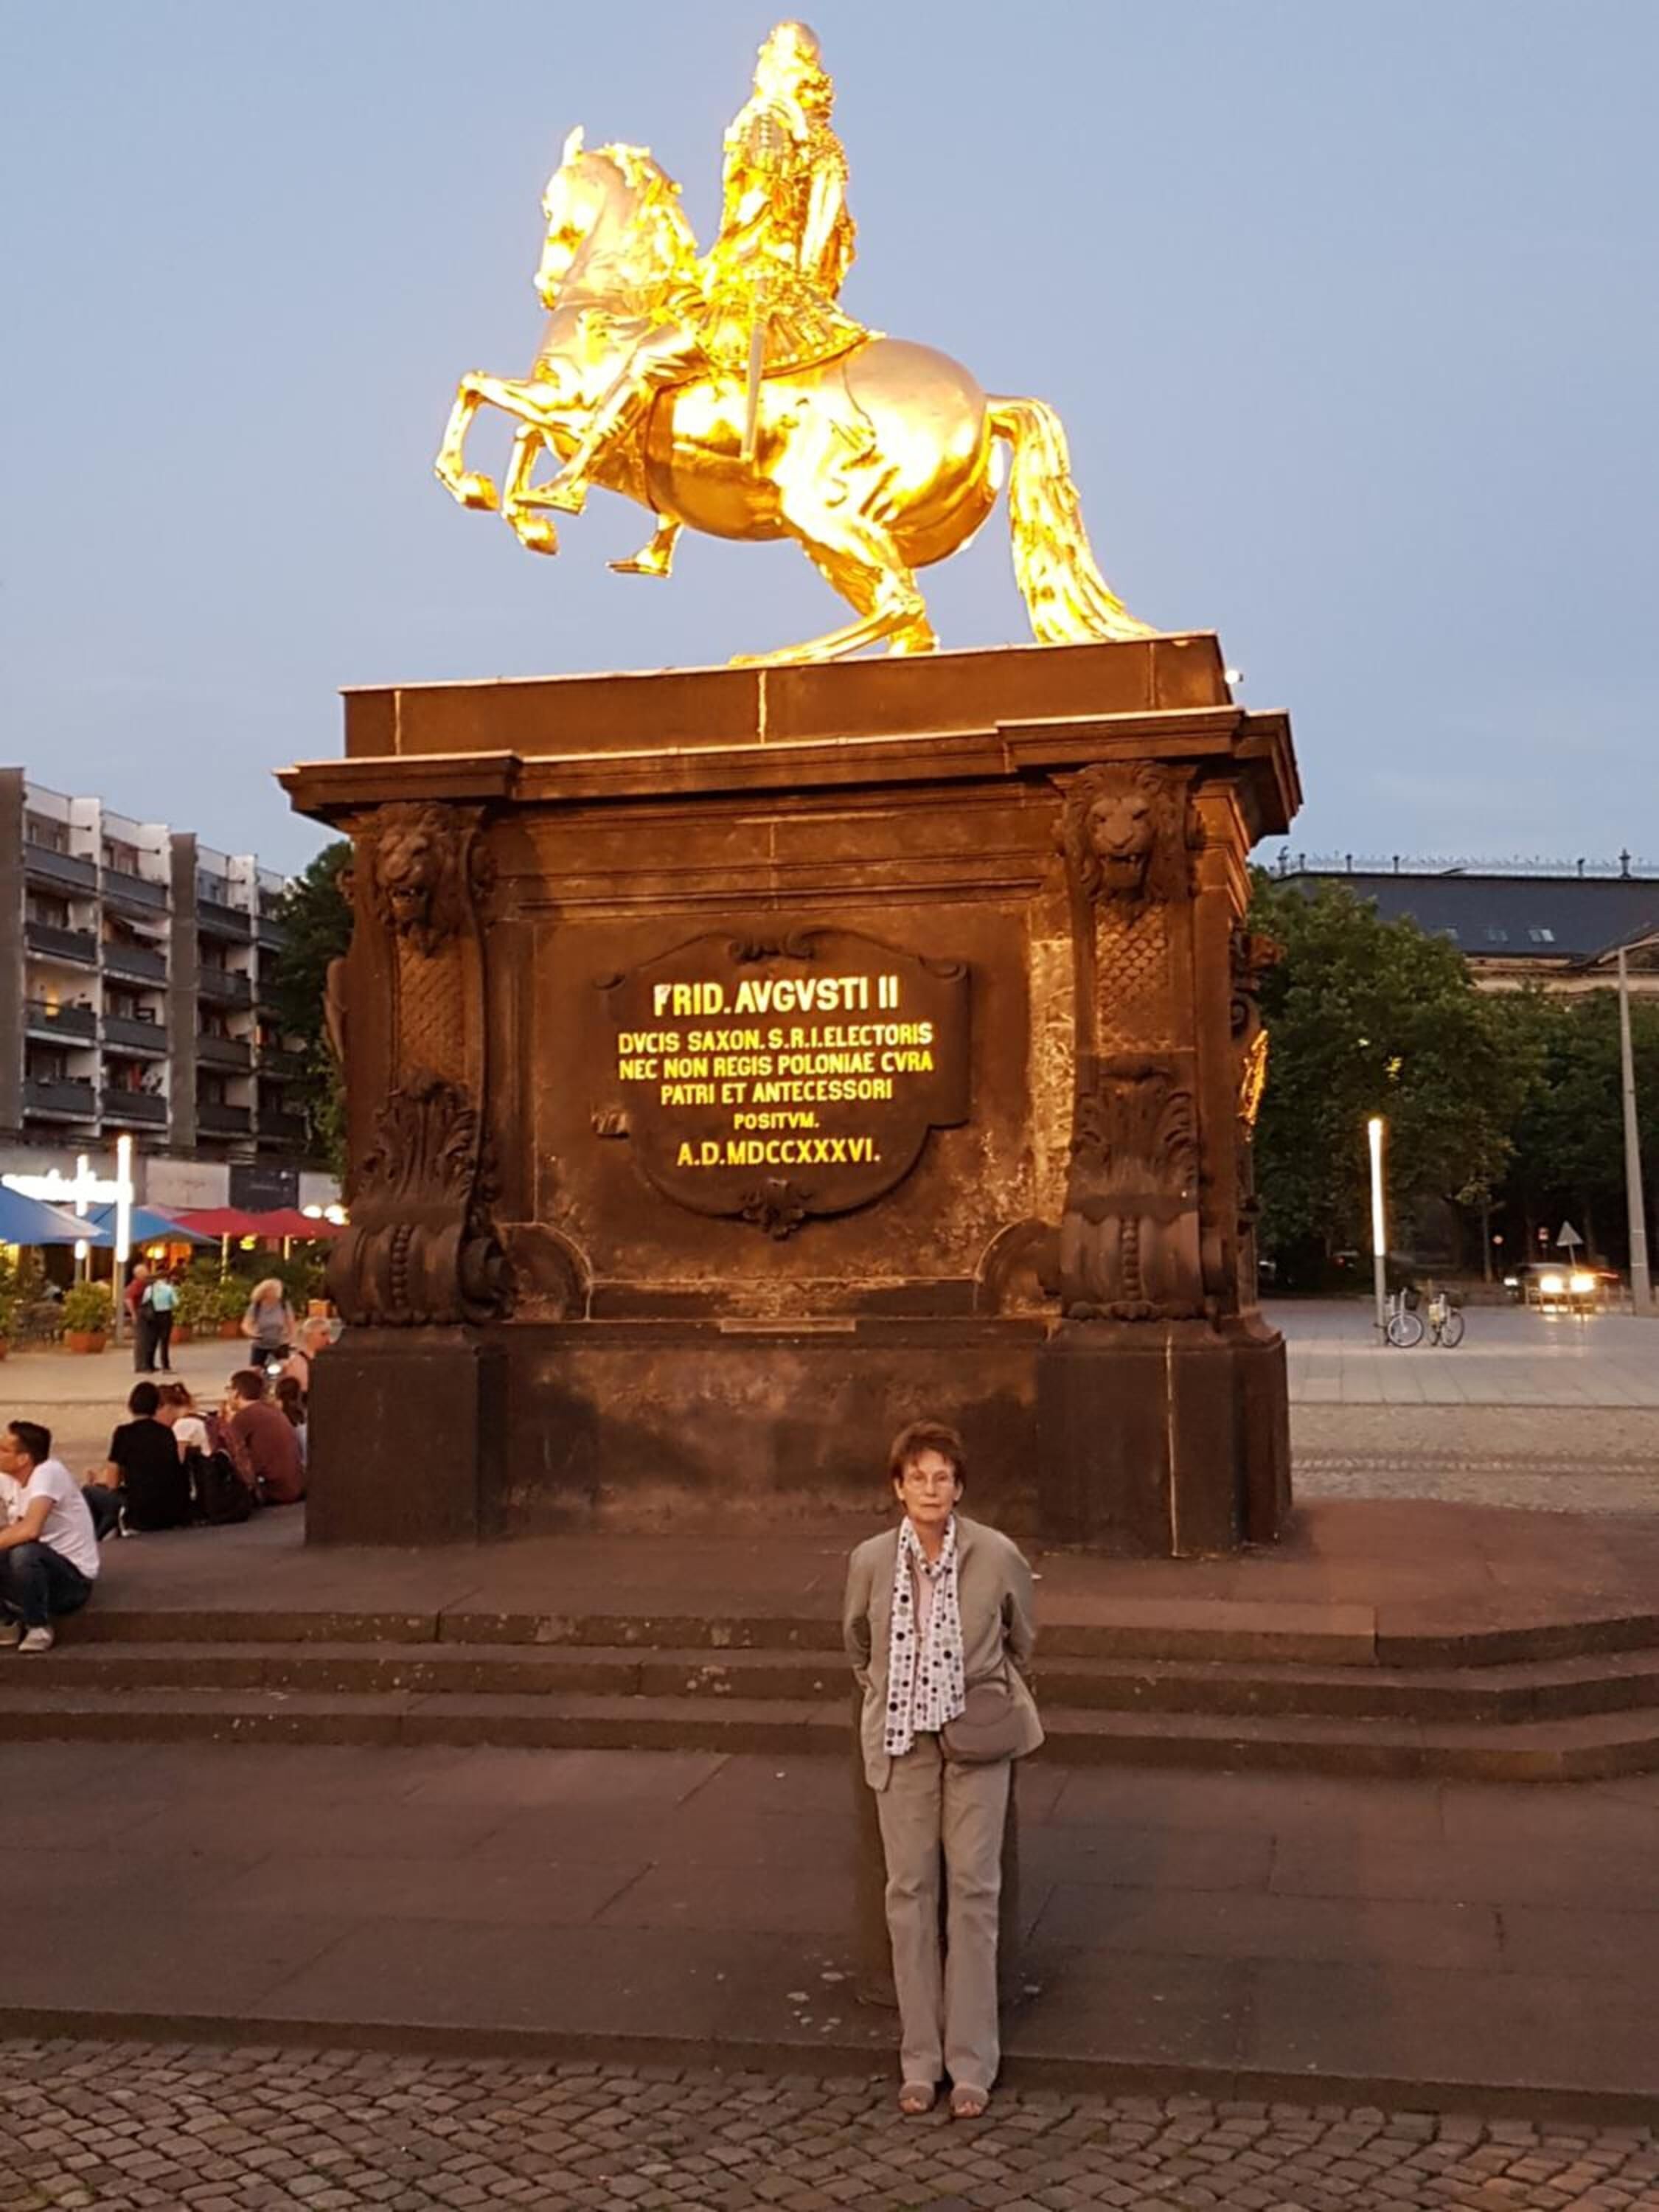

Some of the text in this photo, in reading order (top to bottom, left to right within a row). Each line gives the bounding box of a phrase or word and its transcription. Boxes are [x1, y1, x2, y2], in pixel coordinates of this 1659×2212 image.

[654, 975, 899, 1017] FRID. AVGVSTI II
[618, 1031, 681, 1054] DVCIS
[687, 1028, 765, 1052] SAXON.
[619, 1050, 934, 1080] NEC NON REGIS POLONIAE CVRA
[661, 1078, 893, 1105] PATRI ET ANTECESSORI
[734, 1111, 821, 1130] POSITVM.
